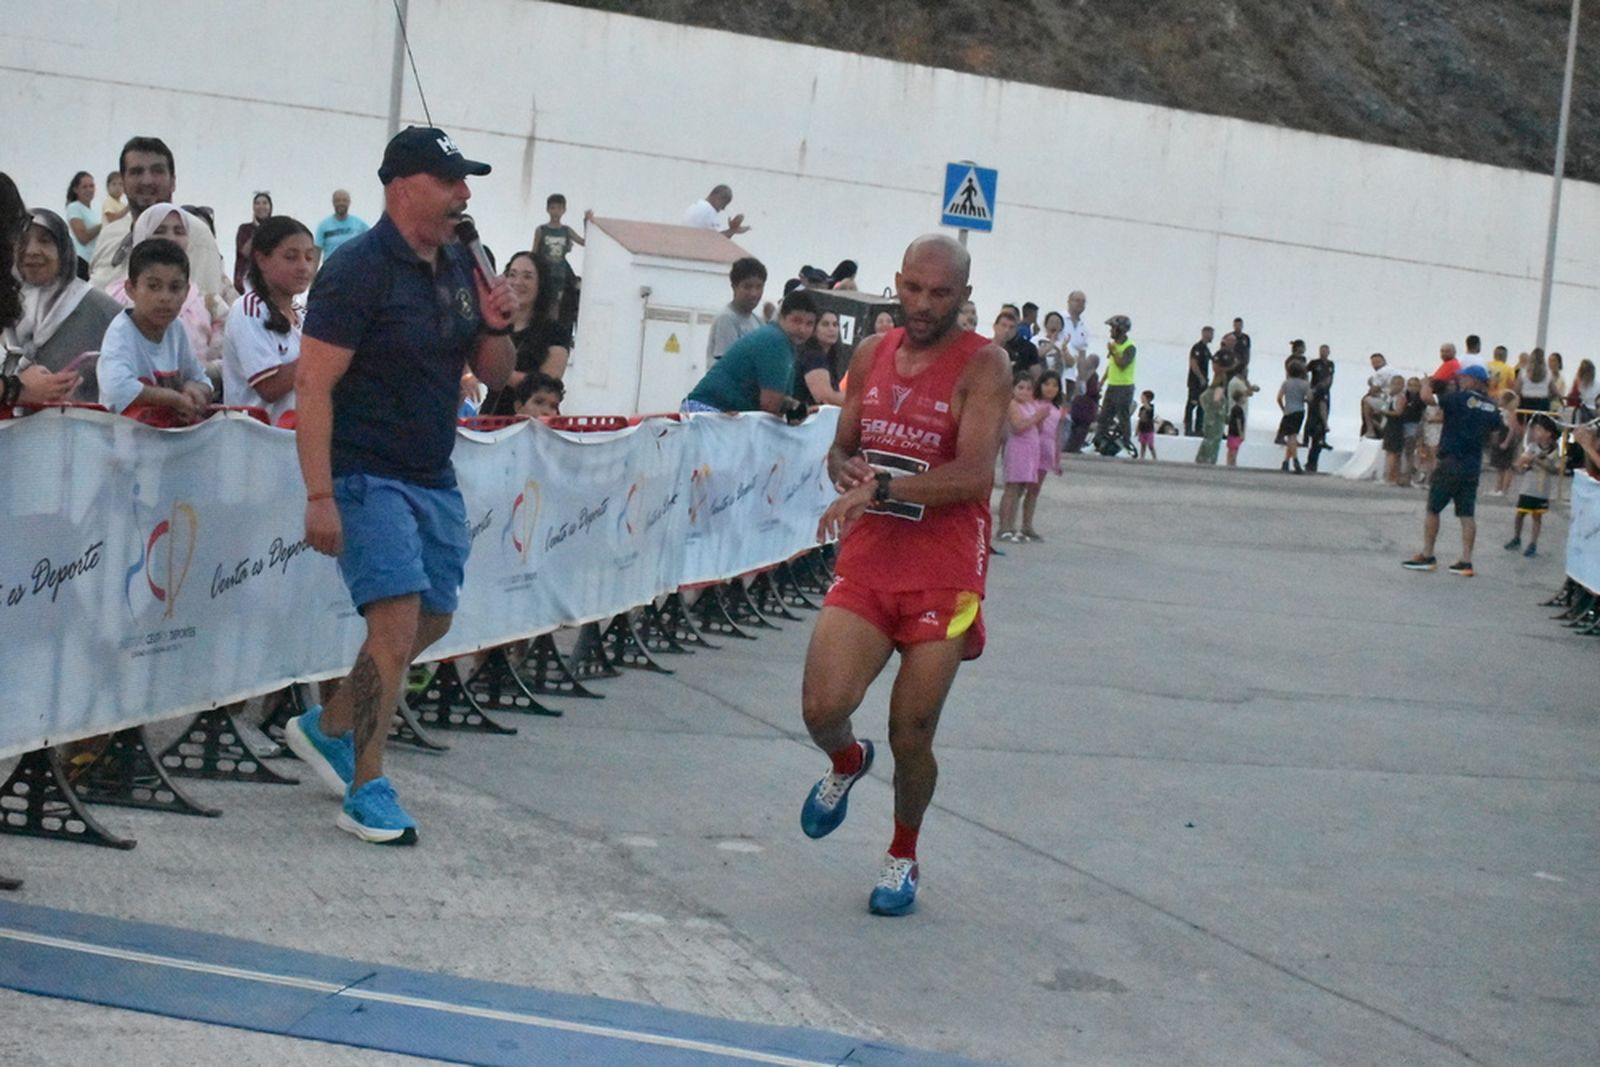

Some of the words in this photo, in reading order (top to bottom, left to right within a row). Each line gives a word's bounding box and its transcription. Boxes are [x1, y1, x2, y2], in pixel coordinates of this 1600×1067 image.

[842, 321, 849, 339] 1
[31, 541, 103, 603] Deporte
[210, 557, 250, 599] Ceuta
